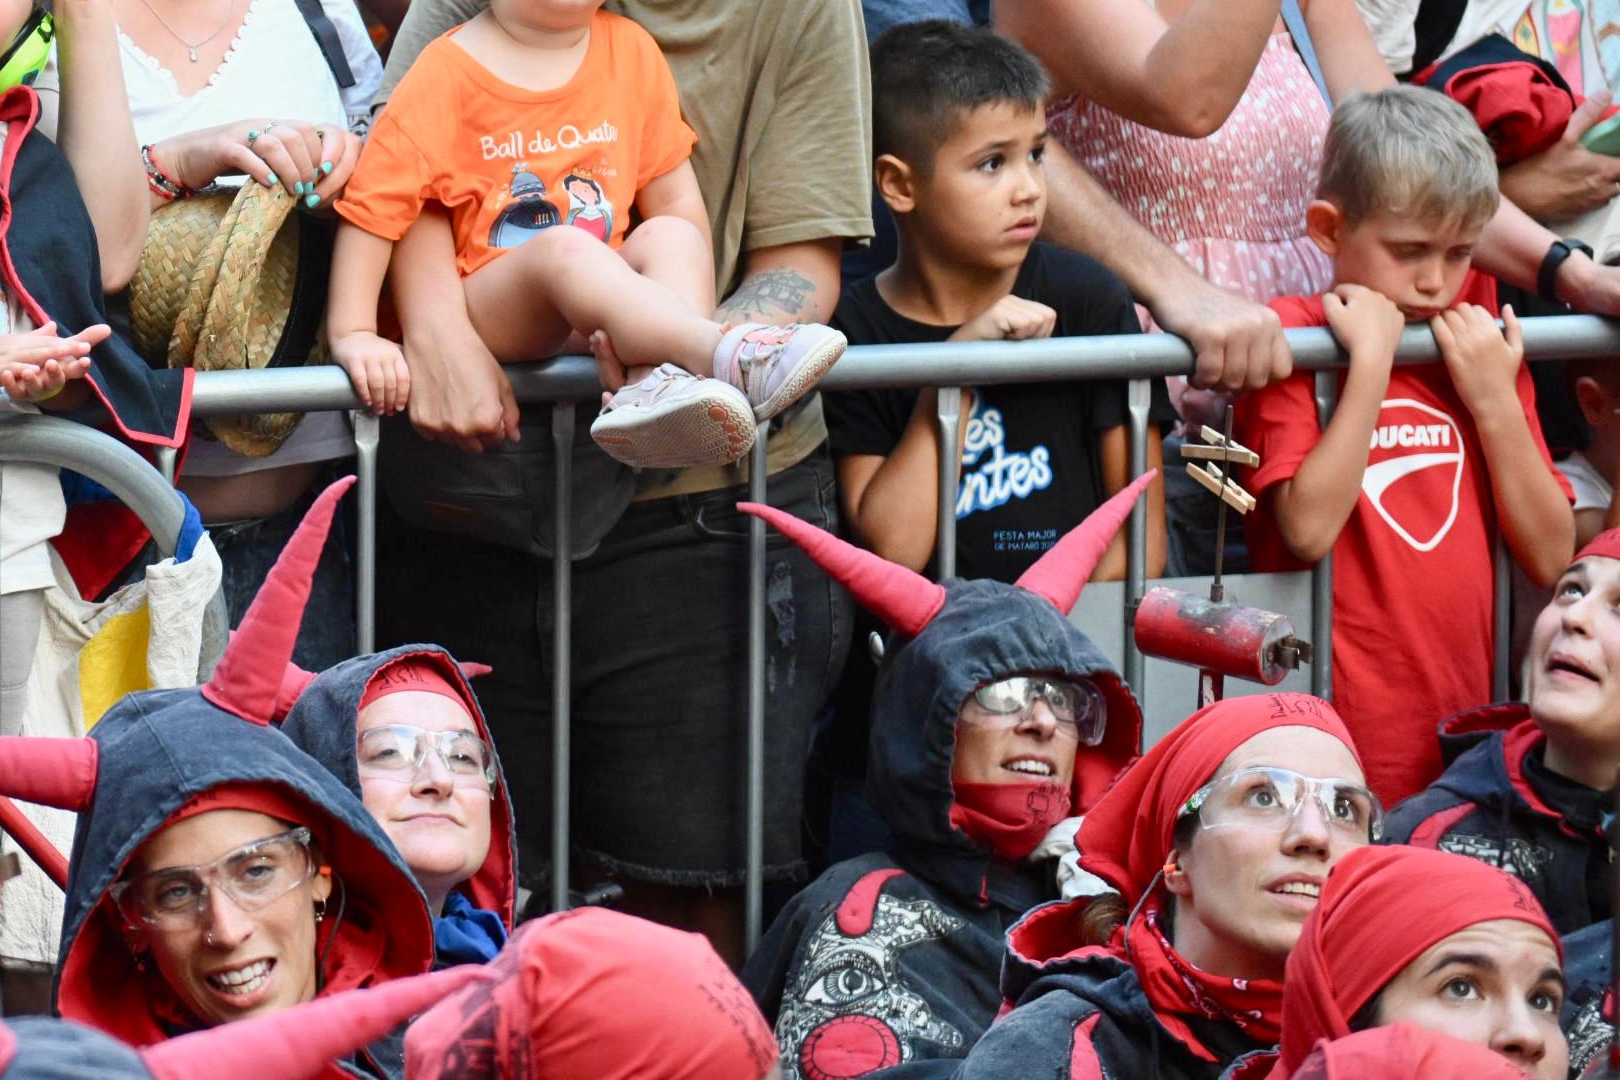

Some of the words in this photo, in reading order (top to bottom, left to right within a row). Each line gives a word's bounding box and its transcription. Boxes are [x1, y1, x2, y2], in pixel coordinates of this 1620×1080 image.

[480, 131, 524, 160] Ball
[529, 131, 557, 153] de
[1027, 528, 1057, 540] MAJOR
